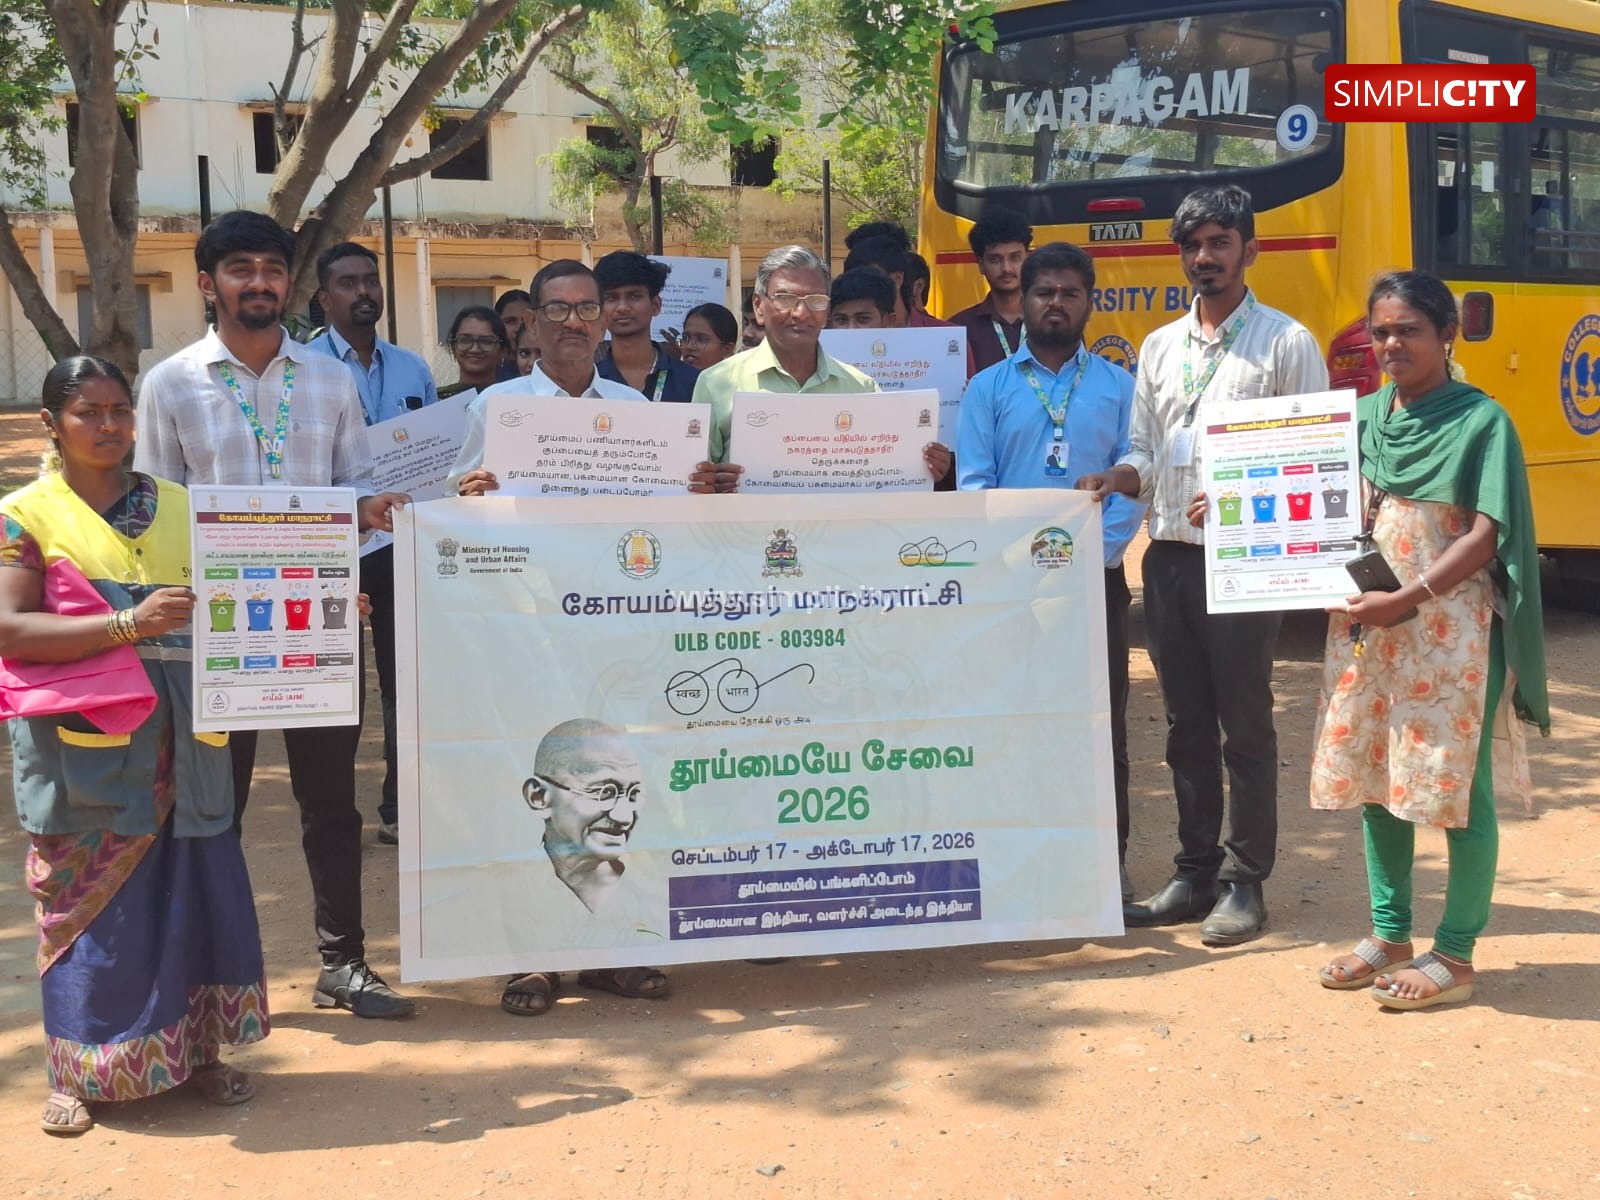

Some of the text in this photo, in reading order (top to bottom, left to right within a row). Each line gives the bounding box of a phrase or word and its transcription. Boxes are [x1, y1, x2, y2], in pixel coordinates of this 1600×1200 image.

[1004, 67, 1250, 134] KARPAGAM
[1287, 114, 1308, 143] 9
[1091, 223, 1141, 241] TATA
[1091, 286, 1199, 312] RSITY BU
[462, 546, 491, 554] Ministry
[502, 546, 530, 554] Housing
[561, 580, 963, 621] கோயம்புத்தூர் மாநகராட்சி
[674, 632, 708, 652] ULB
[715, 630, 761, 650] CODE
[780, 628, 846, 648] 803984
[676, 690, 701, 699] स्वच्छ
[725, 687, 749, 697] भारत
[686, 718, 737, 729] தூய்மையை
[739, 715, 773, 726] நோக்கி
[669, 739, 974, 791] தூய்மையே சேவை
[777, 785, 870, 824] 2026
[671, 846, 760, 866] செப்டம்பர்
[766, 842, 787, 860] 17
[806, 837, 896, 860] அக்டோபர்
[901, 835, 927, 854] 17,
[932, 832, 975, 850] 2026
[738, 871, 915, 899] தூய்மையில் பங்களிப்போம்
[926, 900, 973, 917] இந்தியா
